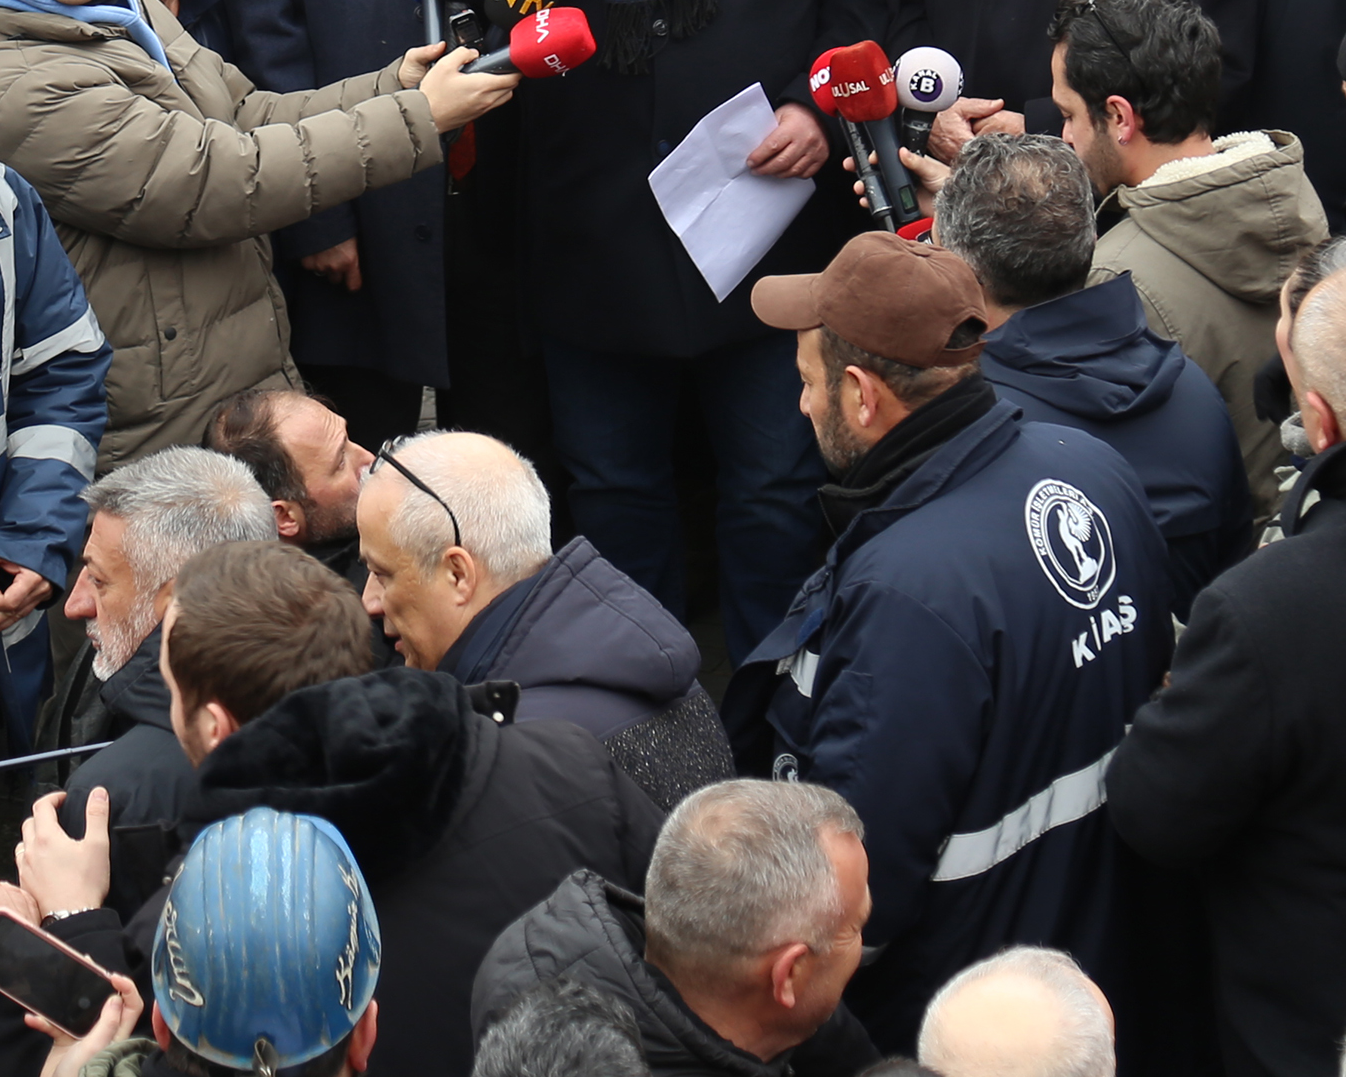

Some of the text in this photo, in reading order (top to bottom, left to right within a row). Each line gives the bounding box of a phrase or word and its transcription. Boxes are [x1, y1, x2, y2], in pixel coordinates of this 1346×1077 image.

[536, 8, 550, 43] DHA
[809, 66, 831, 92] NO
[910, 69, 939, 90] KANAL
[920, 78, 935, 93] B
